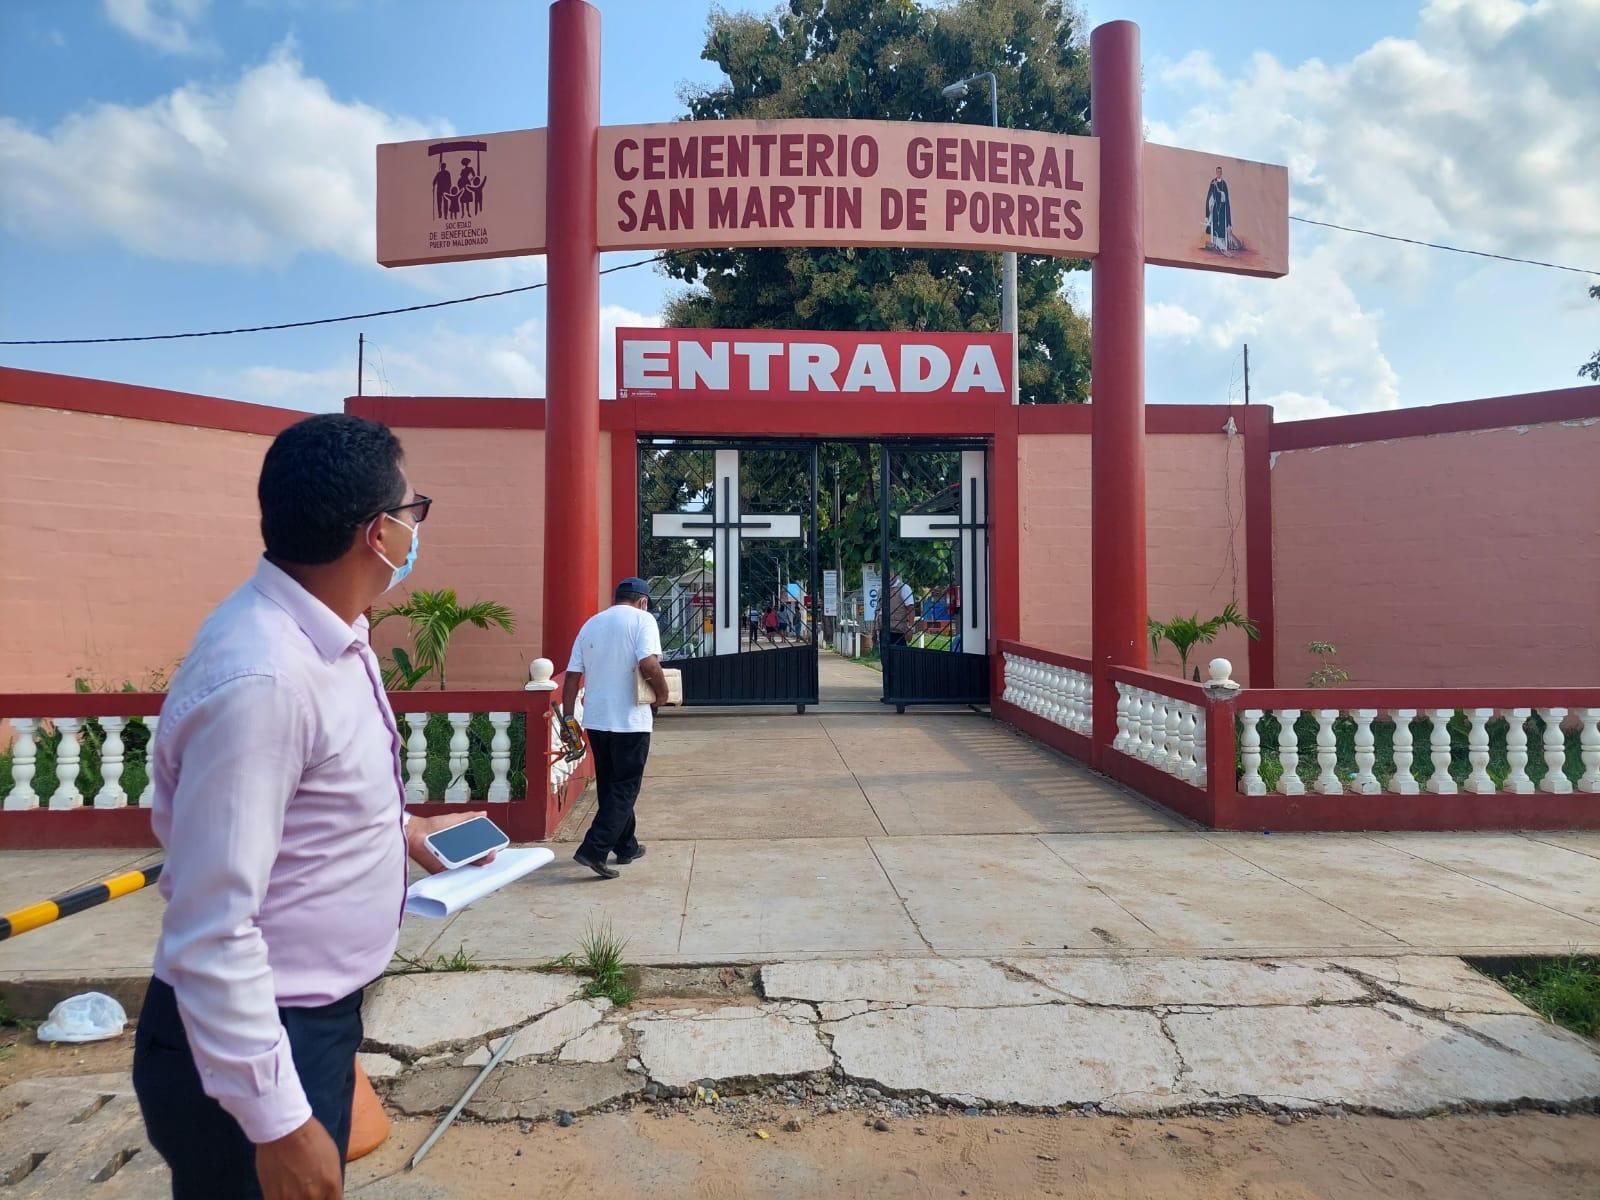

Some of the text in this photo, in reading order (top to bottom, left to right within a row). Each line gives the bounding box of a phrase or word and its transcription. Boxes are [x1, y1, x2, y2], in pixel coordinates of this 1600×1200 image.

[614, 133, 1084, 192] CEMENTERIO GENERAL
[429, 228, 487, 240] DE BENEFICENCIA
[617, 186, 1084, 241] SAN MARTIN DE PORRES
[452, 238, 488, 247] MALDONADO
[622, 339, 1005, 393] ENTRADA
